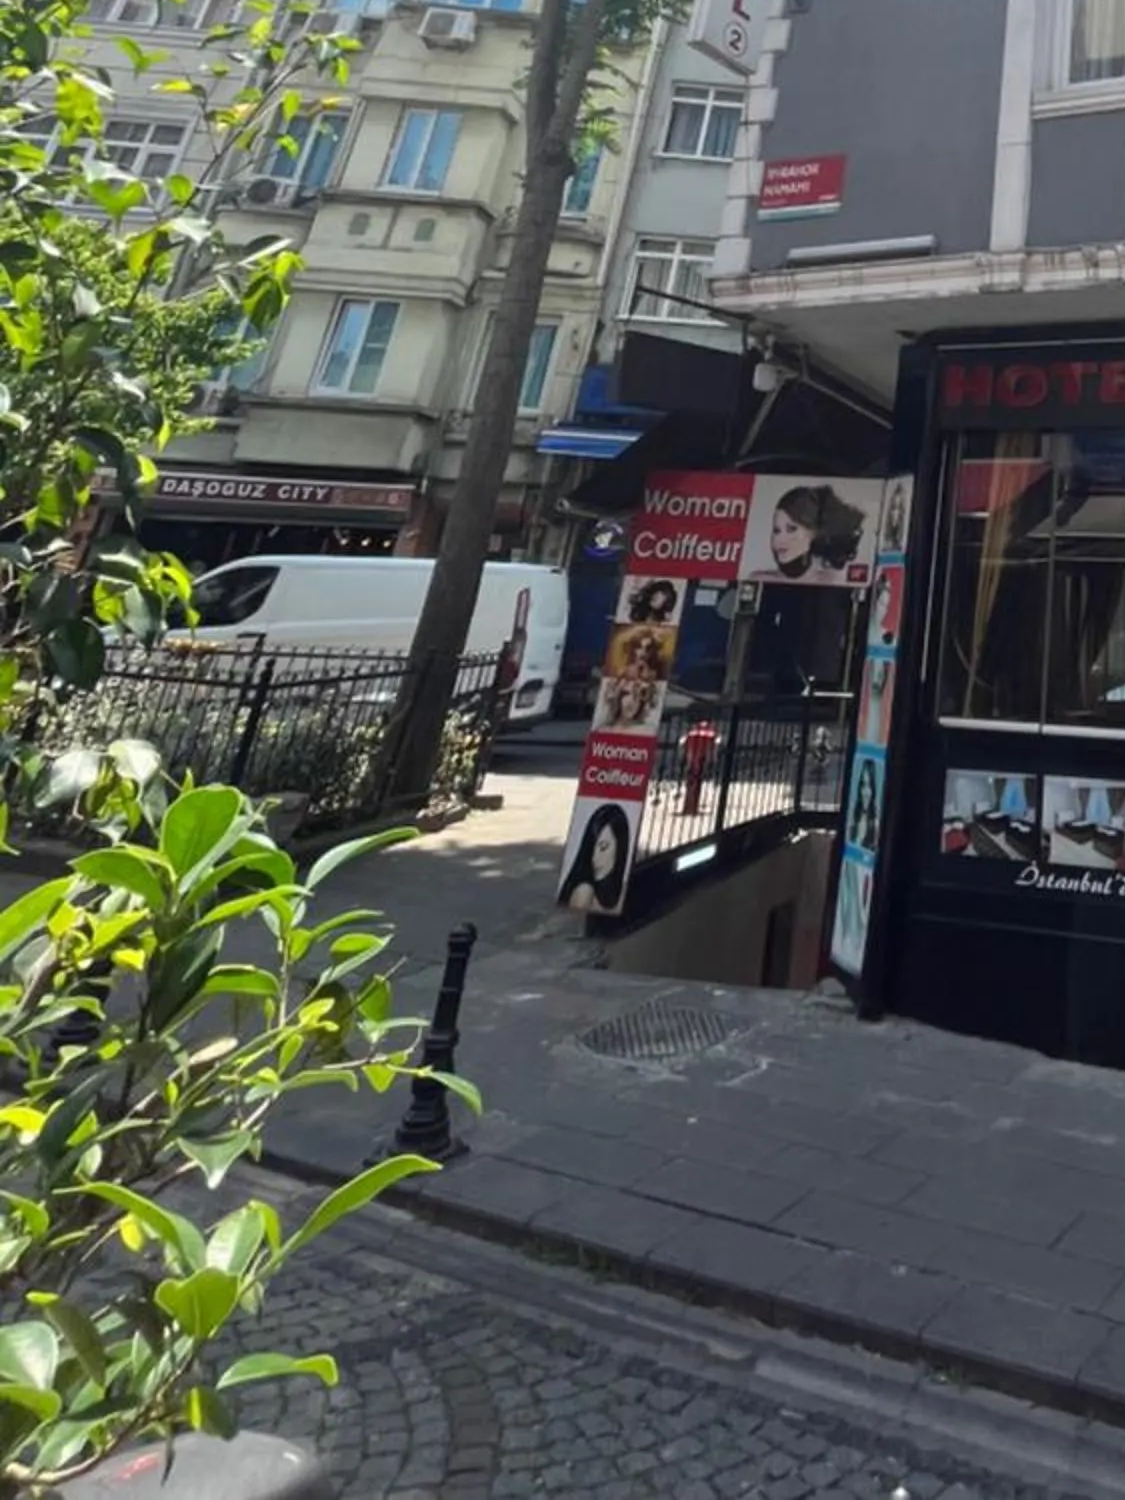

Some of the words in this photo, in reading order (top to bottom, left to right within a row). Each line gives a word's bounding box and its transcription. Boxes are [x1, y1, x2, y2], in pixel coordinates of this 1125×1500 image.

[277, 485, 330, 501] CITY
[644, 488, 746, 519] Woman
[633, 531, 740, 562] Coiffeur
[592, 741, 649, 762] Woman
[585, 766, 646, 786] Coiffeur
